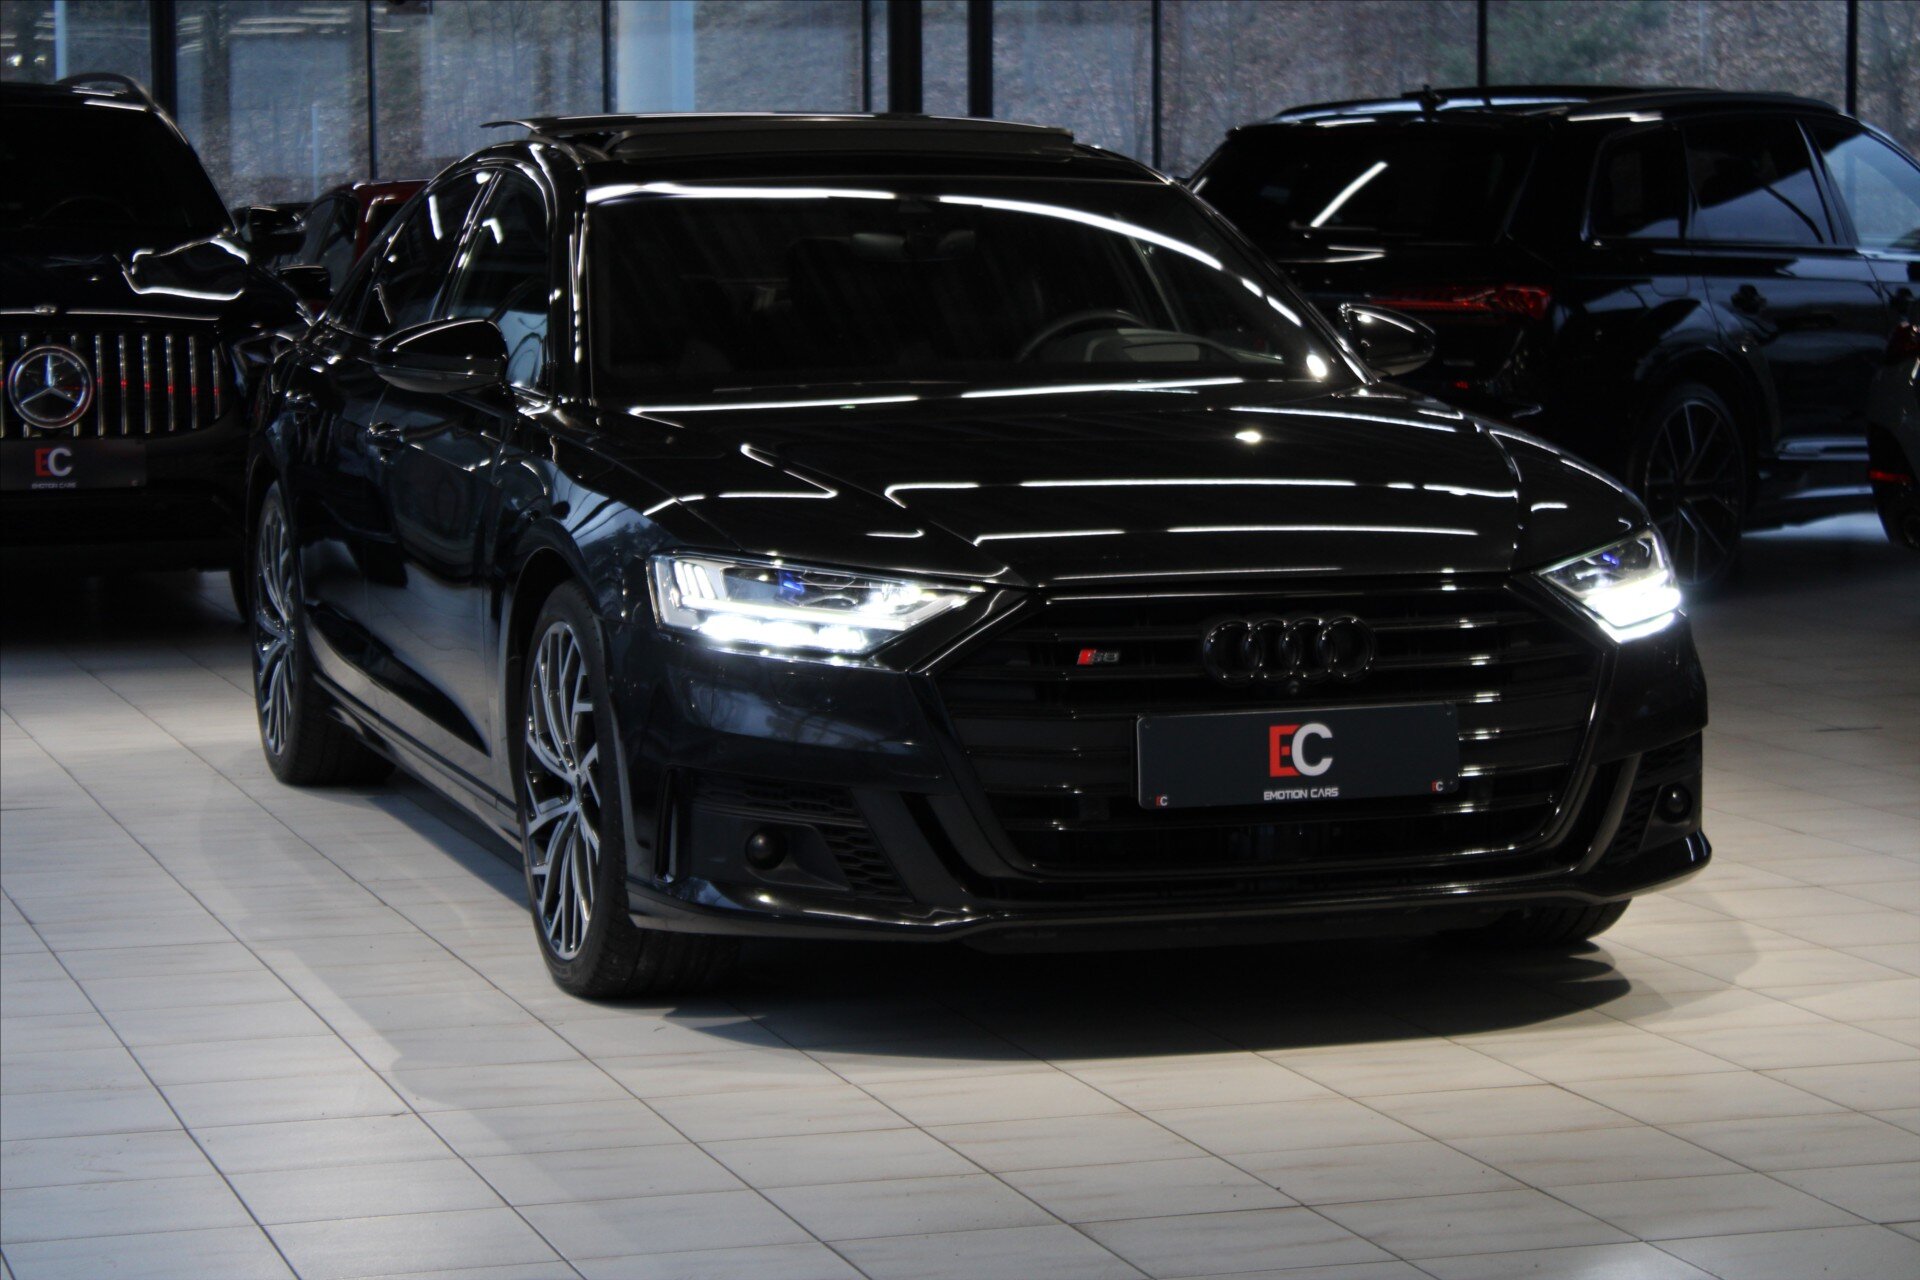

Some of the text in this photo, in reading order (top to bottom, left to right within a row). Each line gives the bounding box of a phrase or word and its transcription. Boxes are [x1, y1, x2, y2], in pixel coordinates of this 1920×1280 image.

[34, 447, 73, 477] EC
[1269, 723, 1333, 778] EC
[1263, 787, 1339, 801] EMOTION CARS
